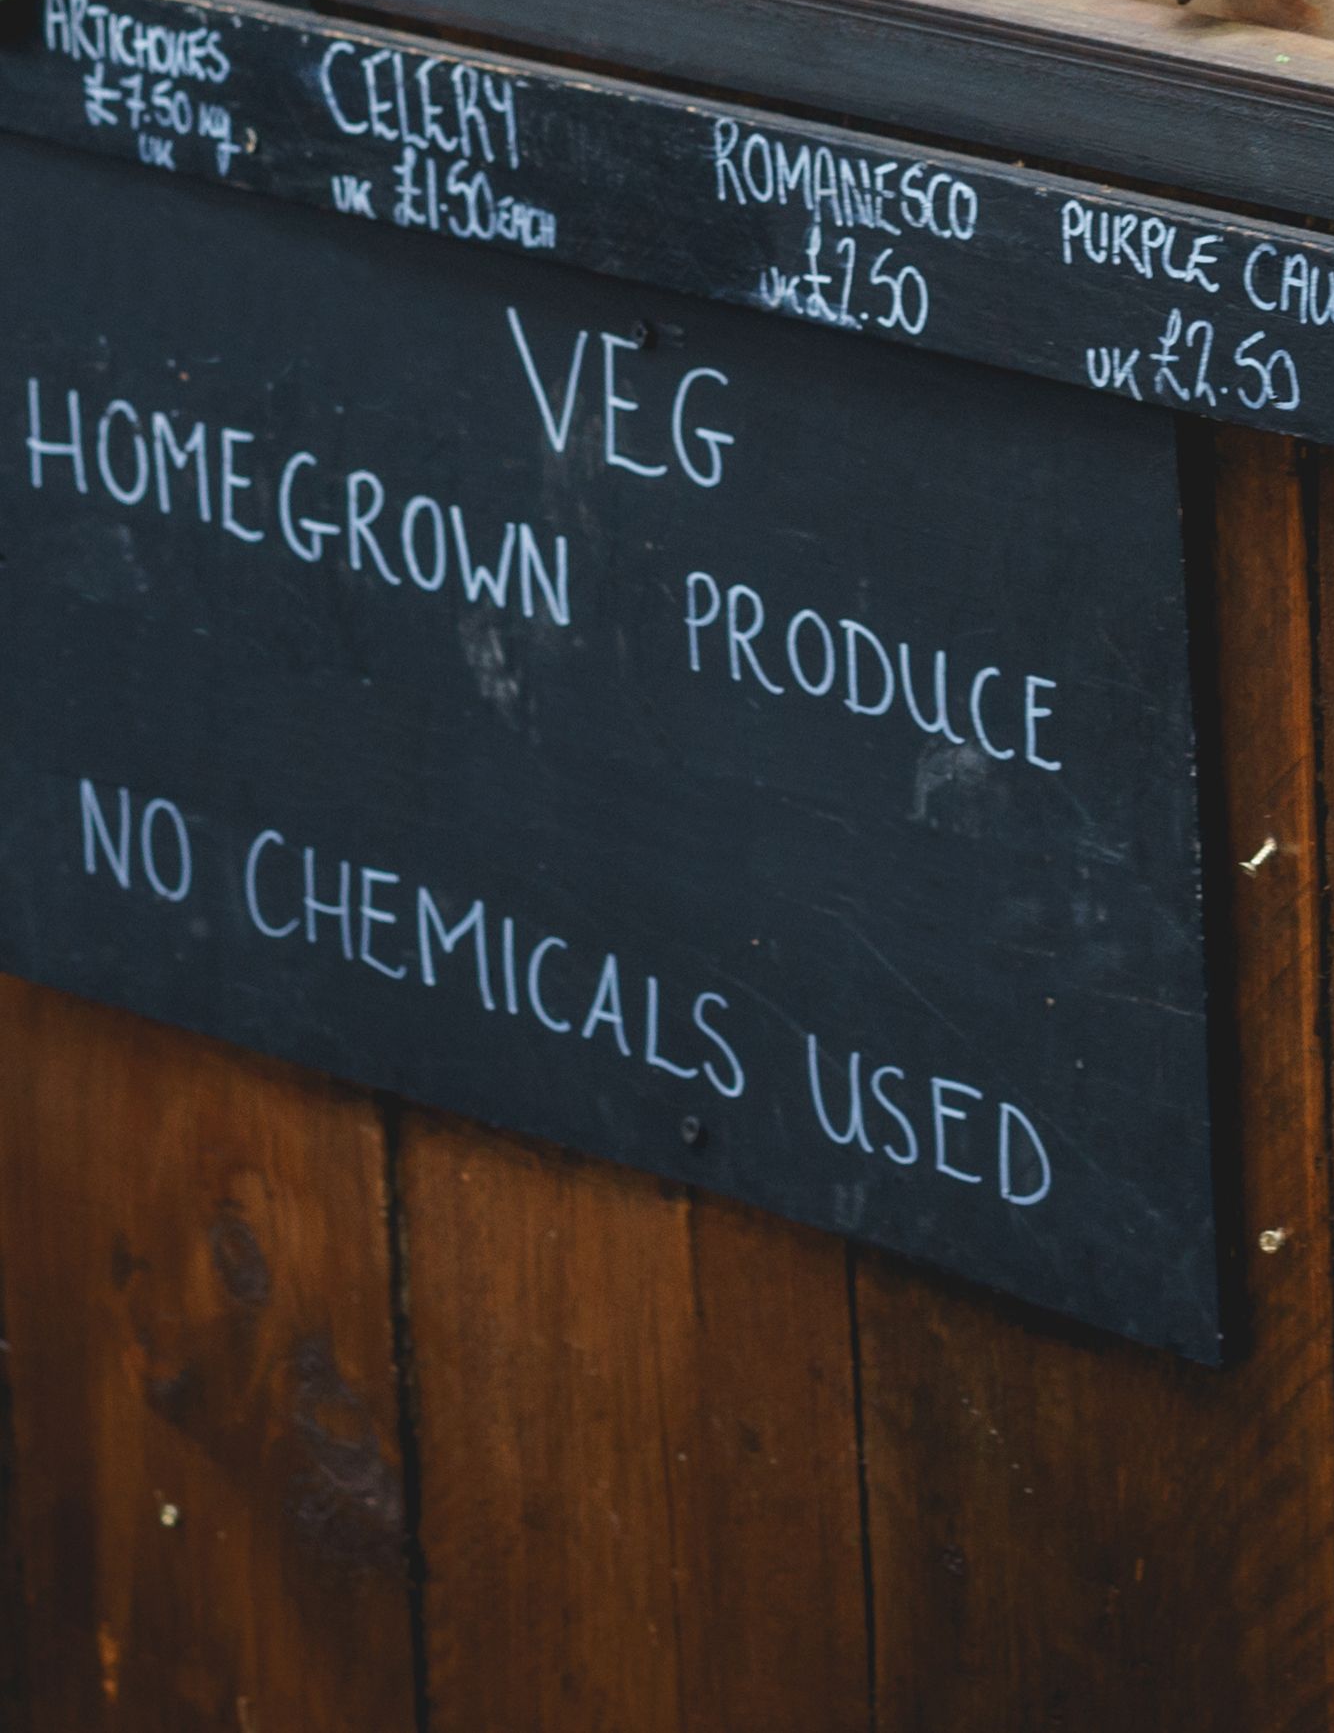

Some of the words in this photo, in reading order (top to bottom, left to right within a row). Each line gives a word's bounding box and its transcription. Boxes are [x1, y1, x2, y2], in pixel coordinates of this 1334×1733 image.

[319, 41, 520, 167] CELERY
[331, 175, 376, 220] UK
[714, 117, 979, 241] ROMANESCO
[1061, 200, 1223, 293] PURPLE
[507, 305, 735, 488] VEG
[1086, 347, 1142, 401] UK
[1150, 307, 1300, 411] £2.50
[683, 571, 1063, 772] PRODUCE
[79, 778, 194, 902] NO
[244, 829, 746, 1098] CHEMICALS
[807, 1033, 1052, 1205] USED
